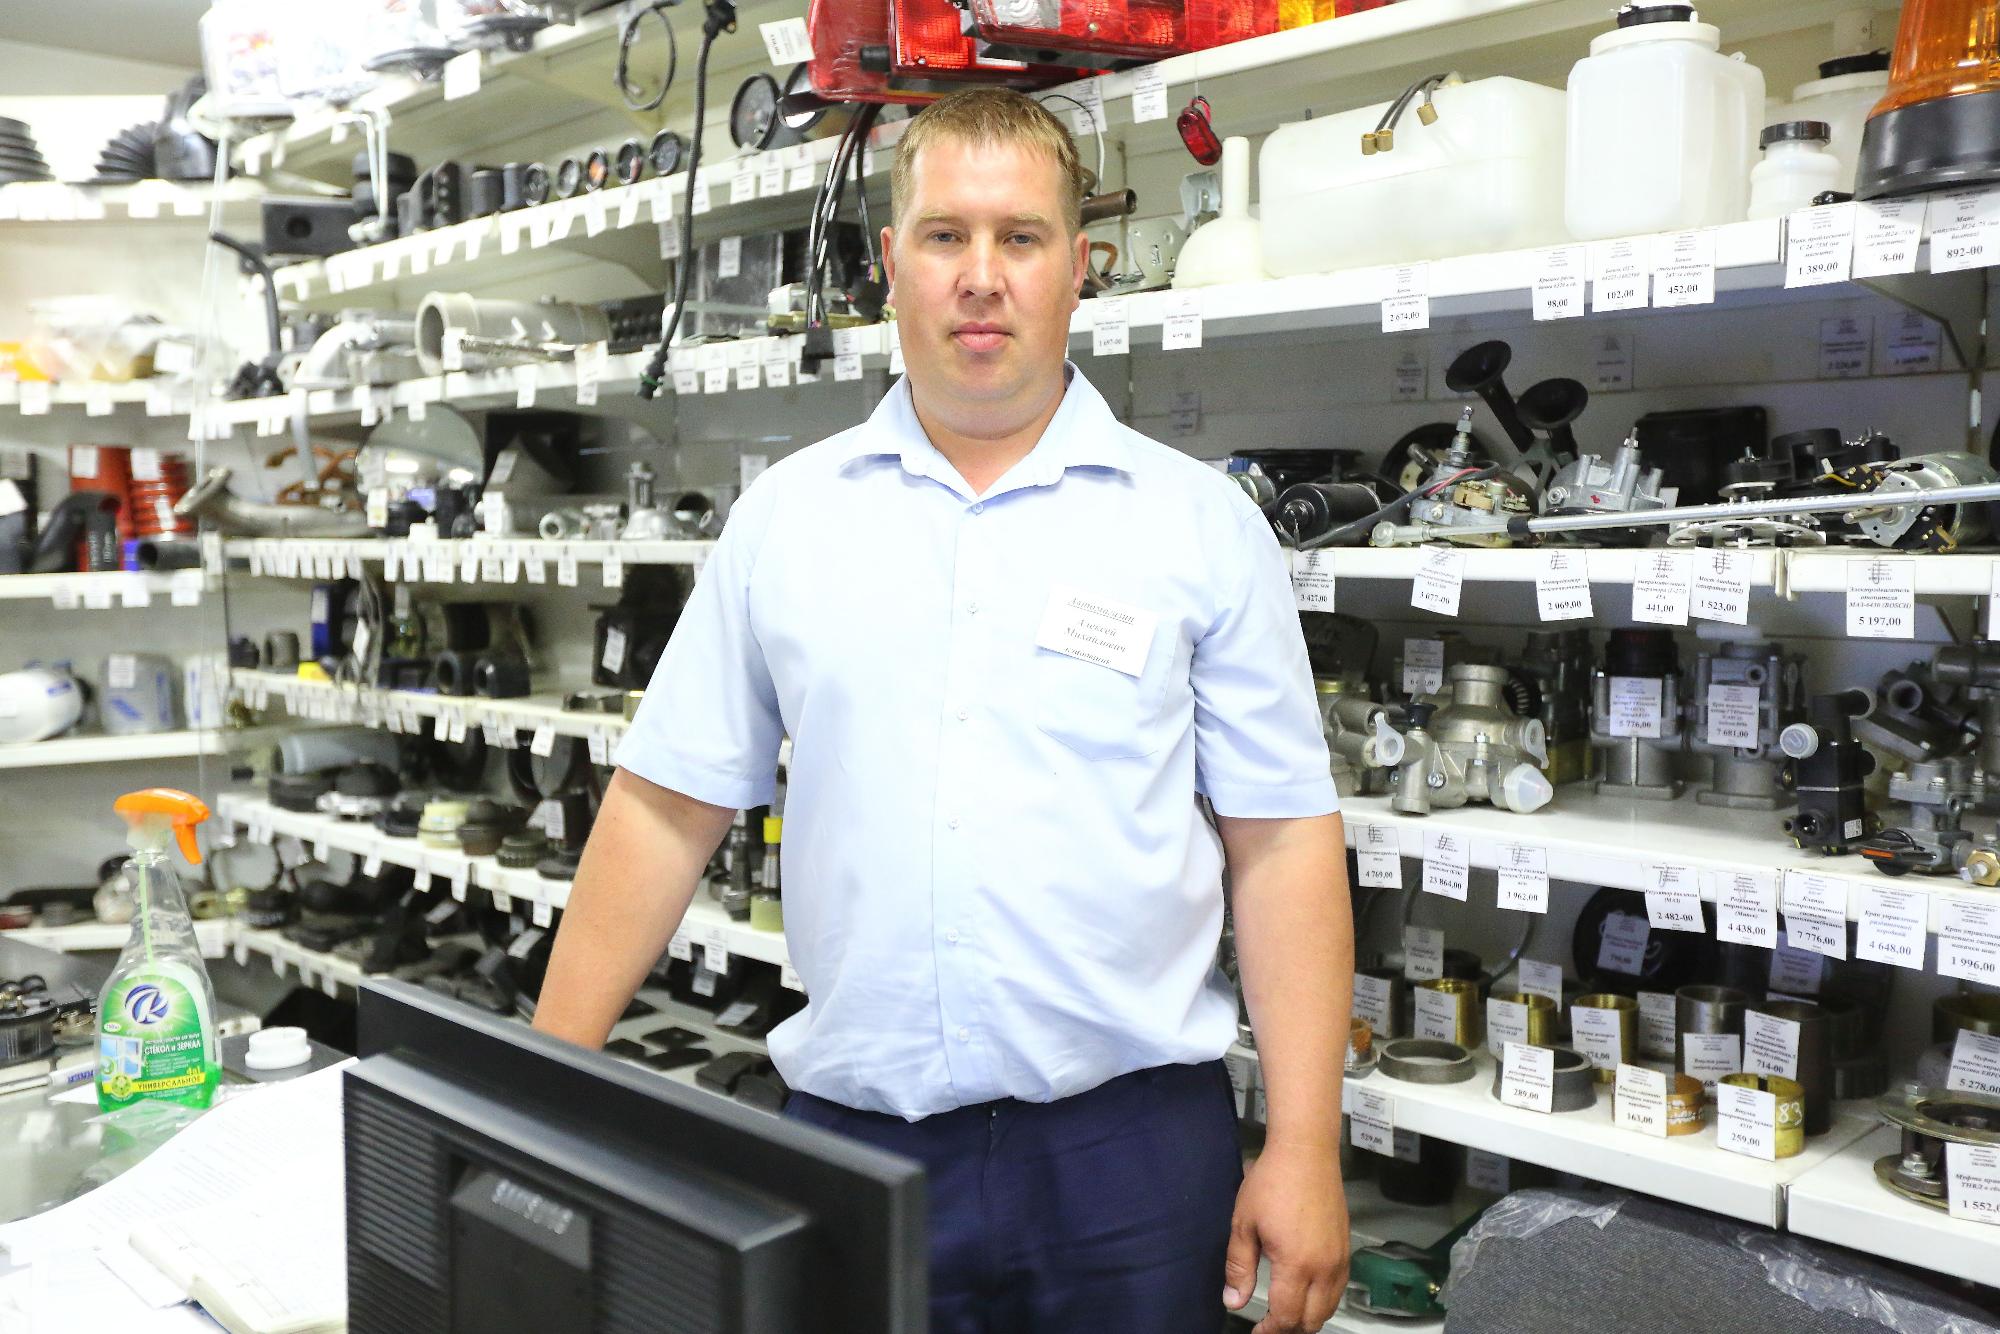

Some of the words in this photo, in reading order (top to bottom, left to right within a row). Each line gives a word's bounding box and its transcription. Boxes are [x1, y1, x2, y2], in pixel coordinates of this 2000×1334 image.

[1946, 245, 1983, 259] 892-00
[1806, 261, 1838, 273] 389,00
[1607, 289, 1634, 300] 102,00
[1667, 284, 1698, 294] 452,00
[1547, 299, 1568, 309] 98,00
[1554, 600, 1582, 610] 069,00
[1646, 603, 1674, 613] 441,00
[1708, 601, 1737, 613] 523,00
[1859, 616, 1865, 626] 5
[1868, 616, 1901, 627] 197,00
[1723, 729, 1749, 738] 681,00
[1371, 870, 1393, 879] 769,00
[1439, 879, 1462, 890] 864,00
[1513, 891, 1538, 902] 962,00
[1656, 912, 1662, 920] 2
[1664, 912, 1694, 922] 482-00
[1728, 923, 1734, 932] 4
[1735, 924, 1766, 936] 438,00
[1805, 932, 1836, 946] 776,00
[1869, 940, 1875, 949] 4
[1878, 941, 1912, 956] 648,00
[1951, 955, 1956, 965] 1
[1960, 957, 1995, 973] 996,00
[176, 1040, 201, 1053] ЗЕРКАЛ
[1757, 1058, 1784, 1073] 714-00
[137, 1075, 201, 1091] УНИВЕРСАЛЬНОЕ
[1960, 1078, 1966, 1087] 5
[1968, 1080, 2000, 1094] 278,00
[1513, 1088, 1539, 1100] 289,00
[1627, 1112, 1653, 1124] 163,00
[1731, 1132, 1760, 1147] 259,00
